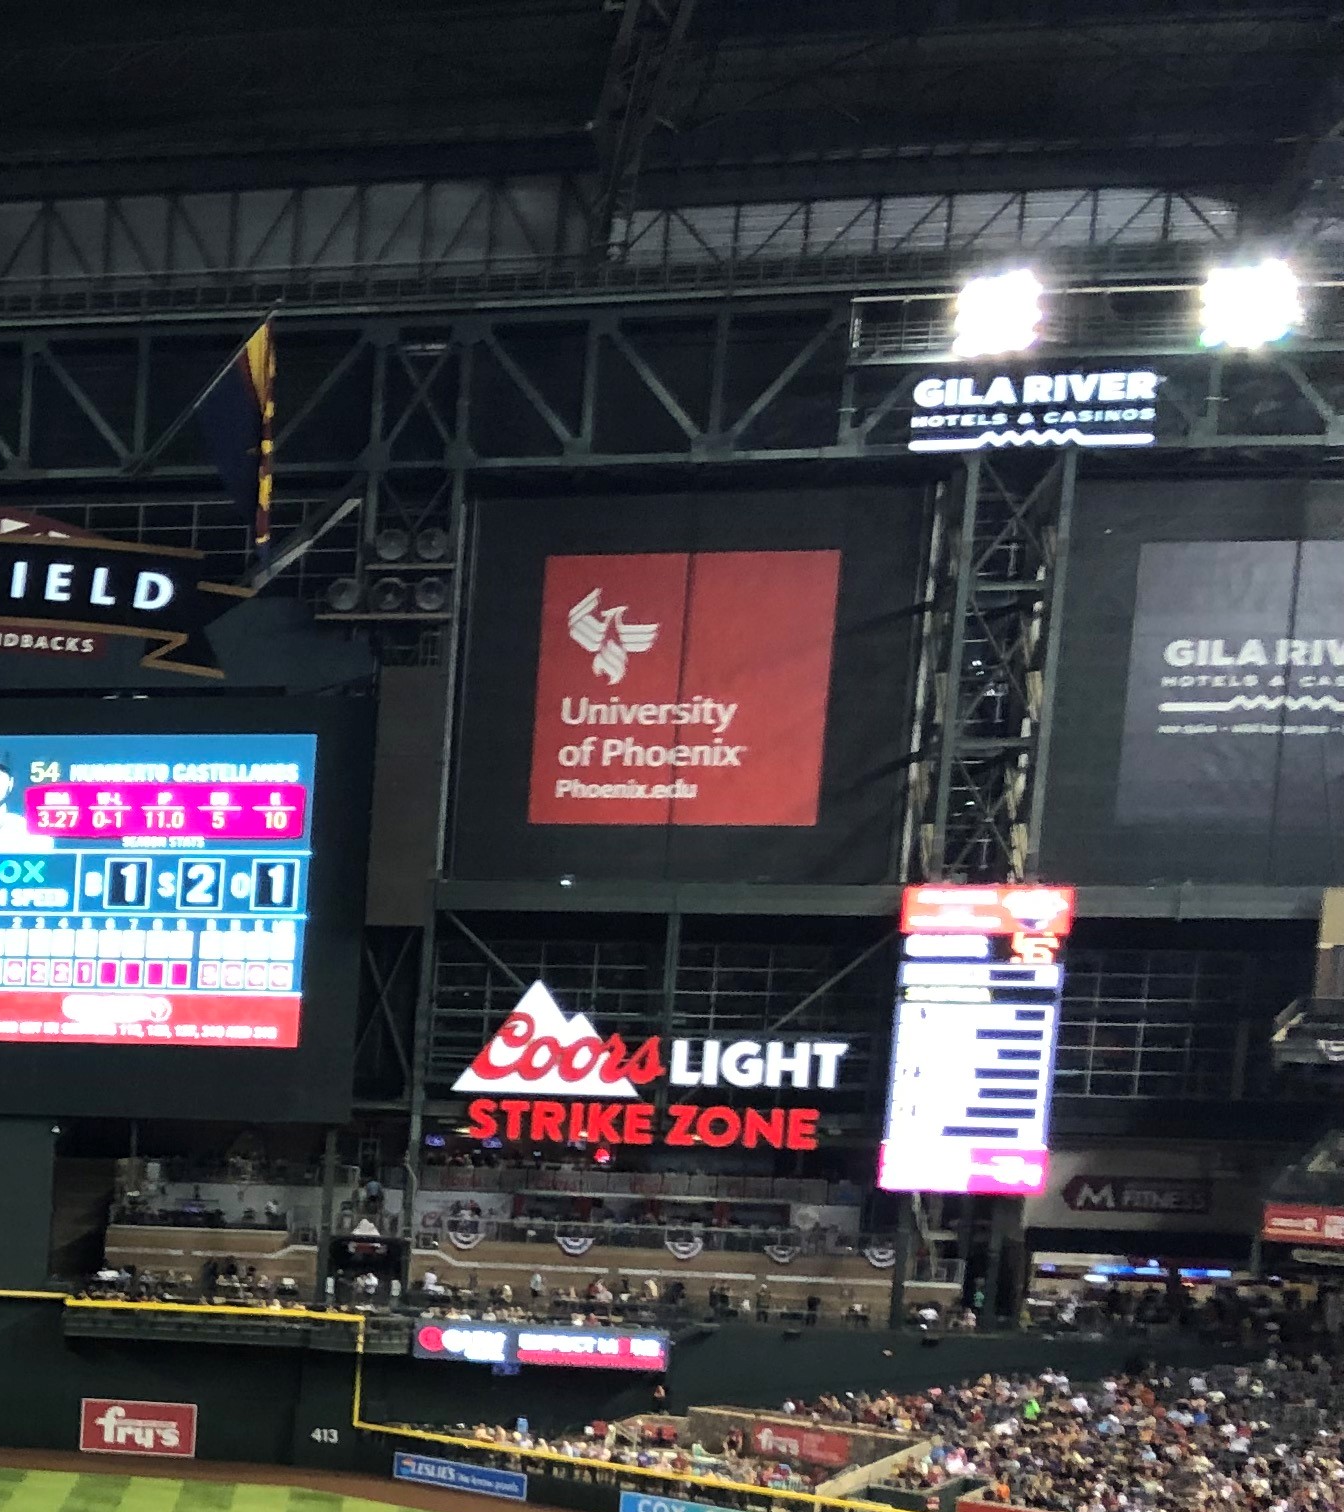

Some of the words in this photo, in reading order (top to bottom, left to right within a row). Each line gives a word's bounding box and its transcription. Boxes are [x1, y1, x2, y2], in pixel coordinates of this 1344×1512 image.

[913, 376, 1017, 407] GILA
[1023, 371, 1157, 402] RIVER
[911, 413, 1008, 428] HOTELS
[1043, 408, 1156, 424] CASINOS
[1163, 639, 1269, 667] GILA
[561, 695, 739, 733] University
[558, 737, 599, 767] of
[602, 737, 742, 767] Phoenix
[30, 761, 60, 783] 54
[555, 779, 699, 799] Phoenix.edu
[37, 811, 80, 828] 3.27
[92, 811, 123, 828] 0-1
[145, 811, 185, 829] 11.0
[212, 812, 225, 829] 5
[265, 812, 288, 829] 10
[119, 864, 139, 904] 1
[158, 872, 176, 897] S
[185, 864, 215, 904] 2
[267, 865, 286, 905] 1
[470, 1012, 666, 1084] Coors
[670, 1040, 850, 1089] LIGHT
[468, 1099, 655, 1146] STRIKE
[664, 1105, 821, 1150] ZONE
[95, 1406, 181, 1449] fry's
[311, 1428, 339, 1444] 413
